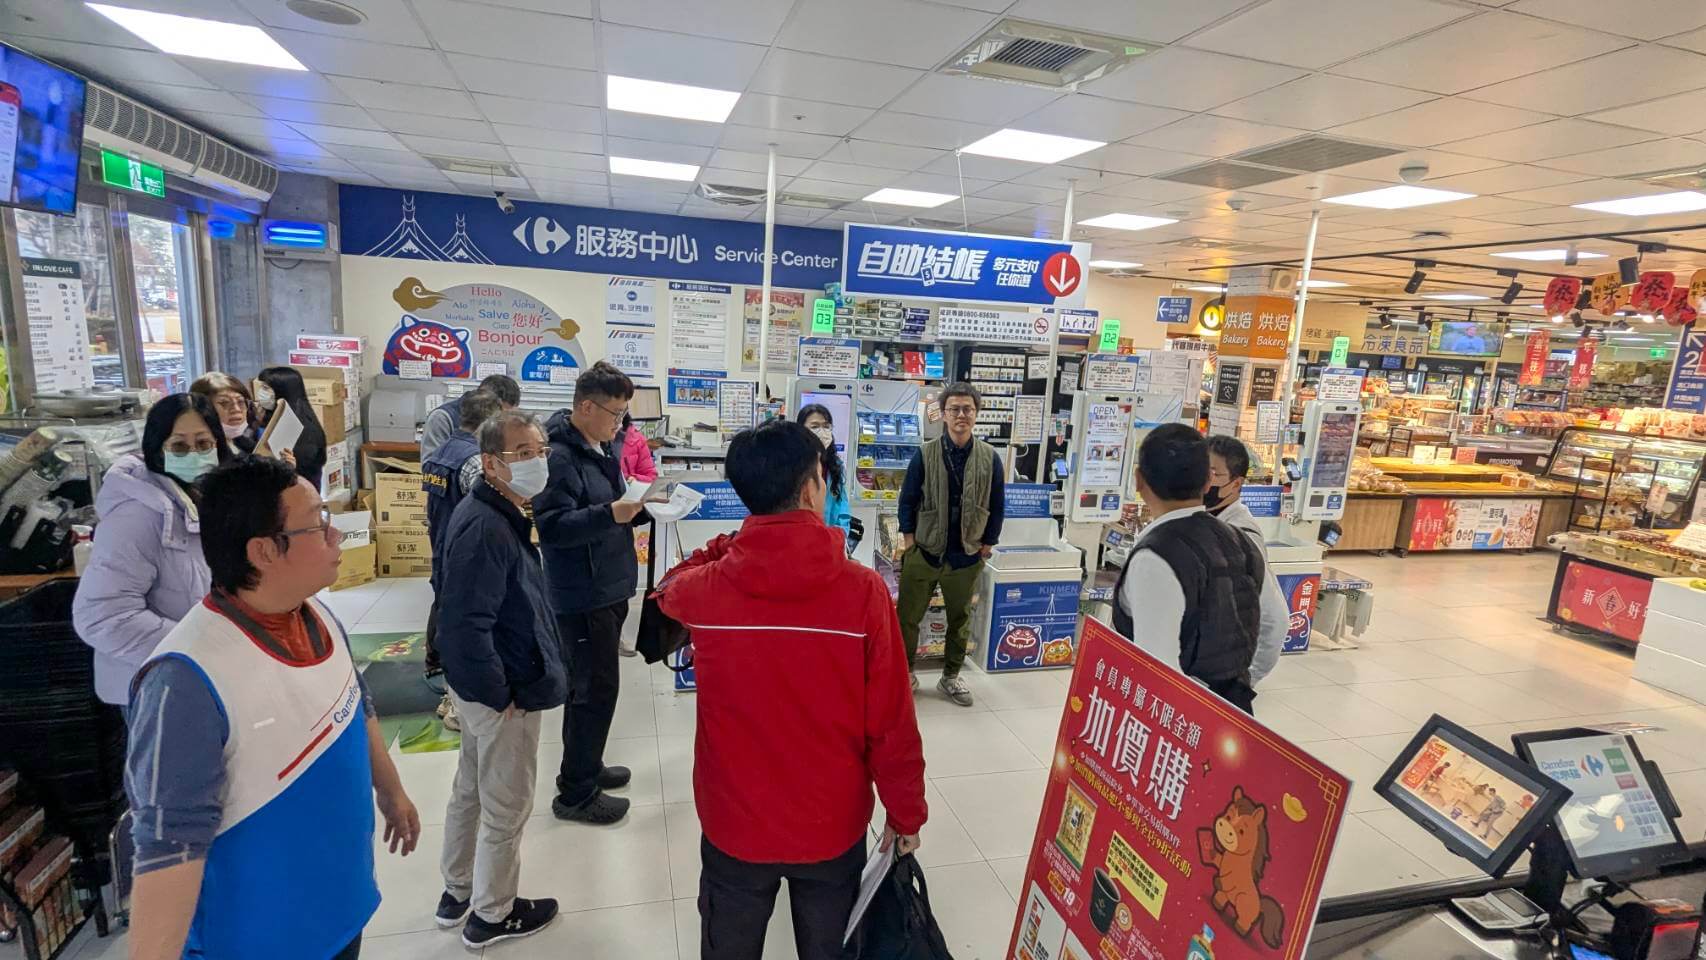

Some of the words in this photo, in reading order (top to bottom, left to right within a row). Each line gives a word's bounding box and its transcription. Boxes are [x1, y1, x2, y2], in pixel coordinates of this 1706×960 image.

[575, 224, 699, 264] 服務中心
[781, 250, 838, 269] Center
[857, 240, 990, 281] 自助結帳
[992, 255, 1041, 274] 多元支付
[996, 271, 1033, 288] 任你選
[471, 286, 502, 297] Hello
[512, 300, 536, 309] Aloha
[478, 309, 510, 320] Salve
[512, 312, 543, 329] 您好
[816, 313, 831, 325] 03
[1224, 311, 1253, 331] 烘焙
[1258, 312, 1290, 332] 烘焙
[478, 329, 544, 346] Bonjour
[1104, 333, 1117, 343] 02
[1222, 334, 1249, 347] Bakery
[1256, 335, 1287, 350] Bakery
[1093, 406, 1116, 415] OPEN
[1489, 458, 1522, 466] PROMOTION
[1039, 585, 1078, 594] KINMEN
[1094, 657, 1147, 711] 會員專屬
[1147, 693, 1202, 750] 不限金額
[1079, 685, 1193, 821] 加價購
[1063, 886, 1076, 906] 19
